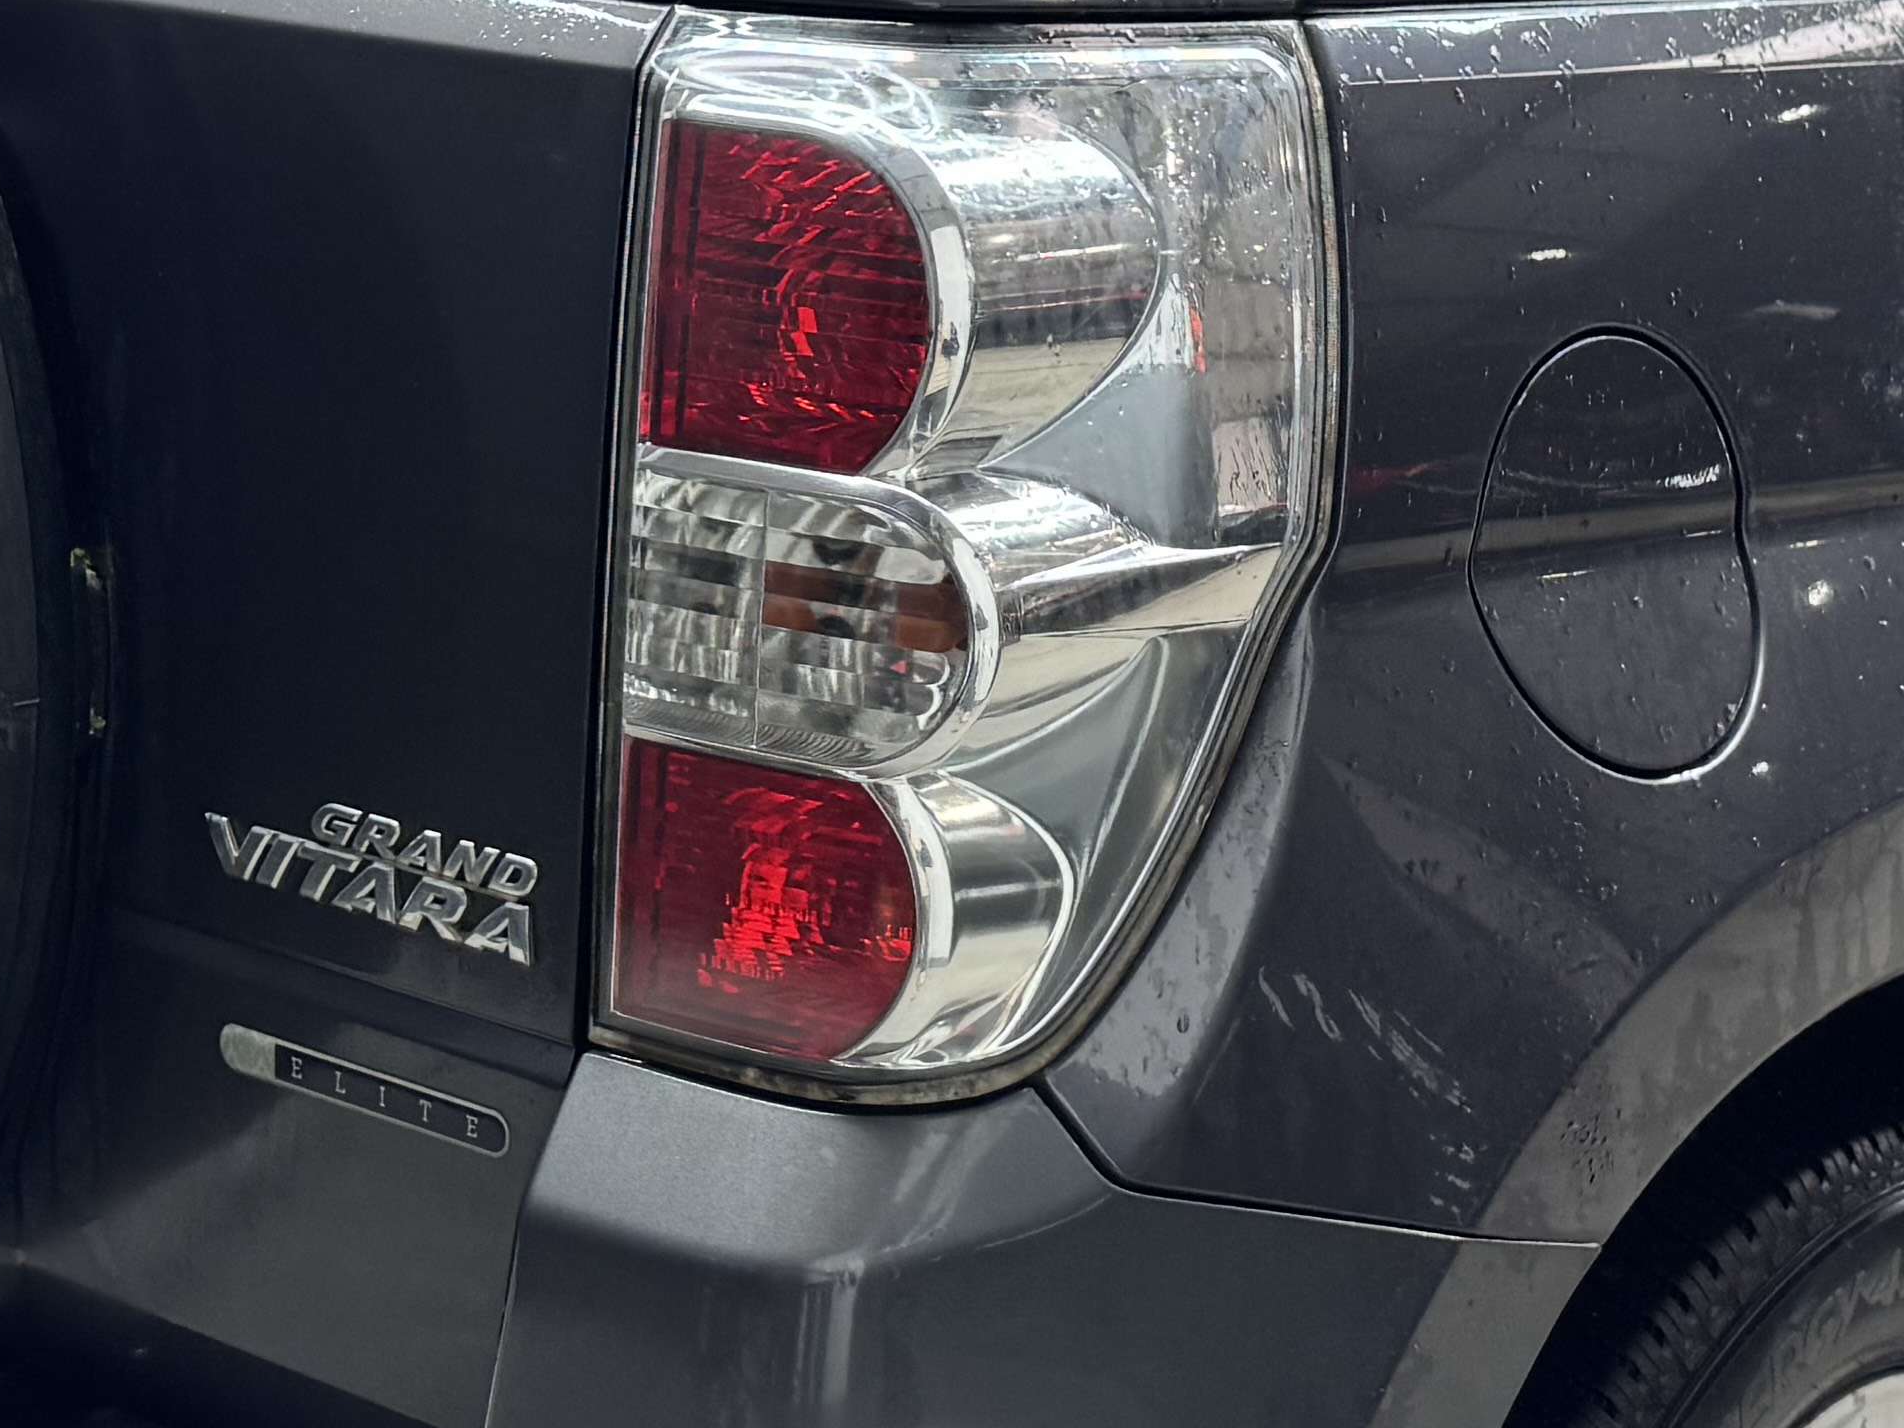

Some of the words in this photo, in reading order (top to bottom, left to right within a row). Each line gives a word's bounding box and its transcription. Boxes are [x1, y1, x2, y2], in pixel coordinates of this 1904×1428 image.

[204, 811, 534, 966] VITARA
[311, 802, 538, 898] GRAND
[291, 1057, 479, 1139] ELITE
